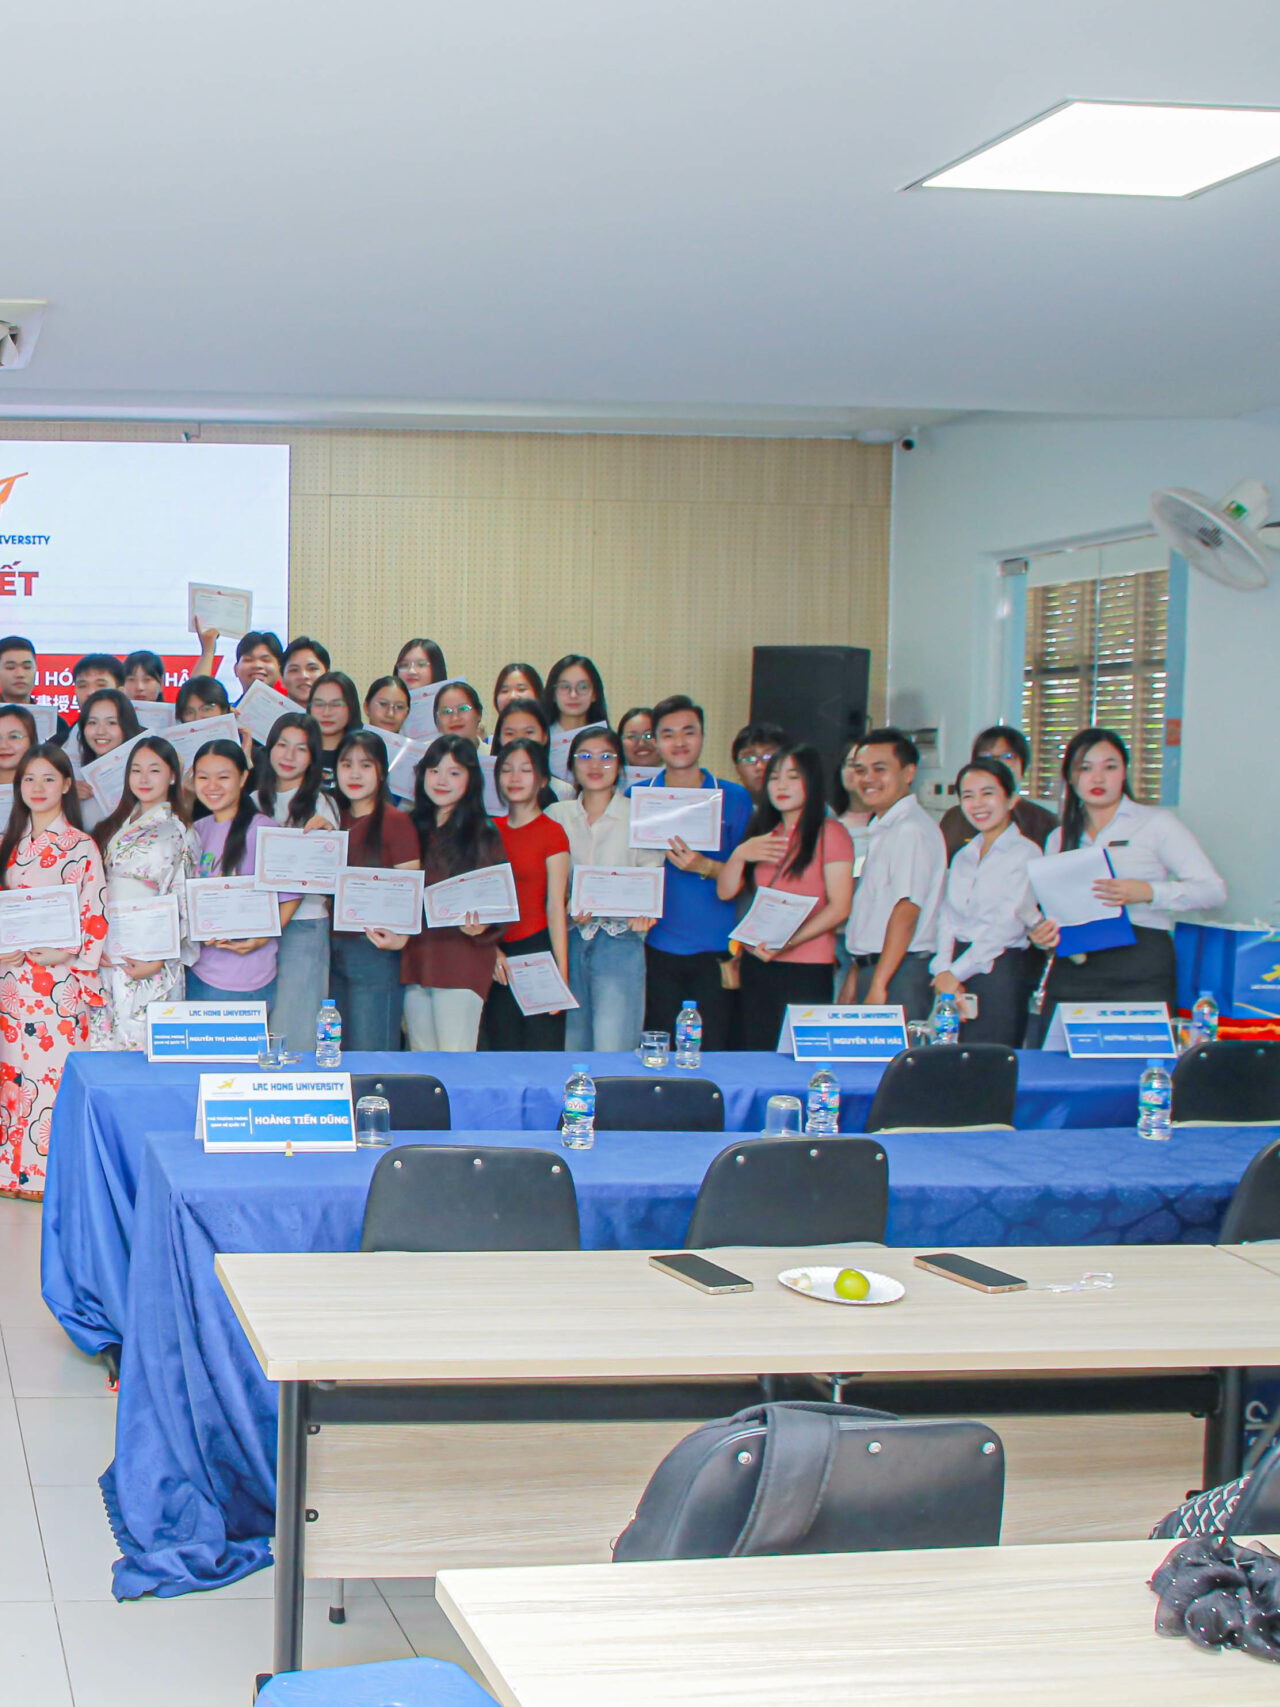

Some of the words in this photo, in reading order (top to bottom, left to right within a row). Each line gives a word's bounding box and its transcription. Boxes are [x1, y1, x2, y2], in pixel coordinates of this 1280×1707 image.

[45, 667, 76, 687] HÓ
[252, 1082, 269, 1091] LAC
[271, 1082, 294, 1091] HONG
[295, 1082, 345, 1091] UNIVERSITY
[254, 1113, 292, 1125] HOÀNG
[320, 1113, 350, 1125] DŨNG
